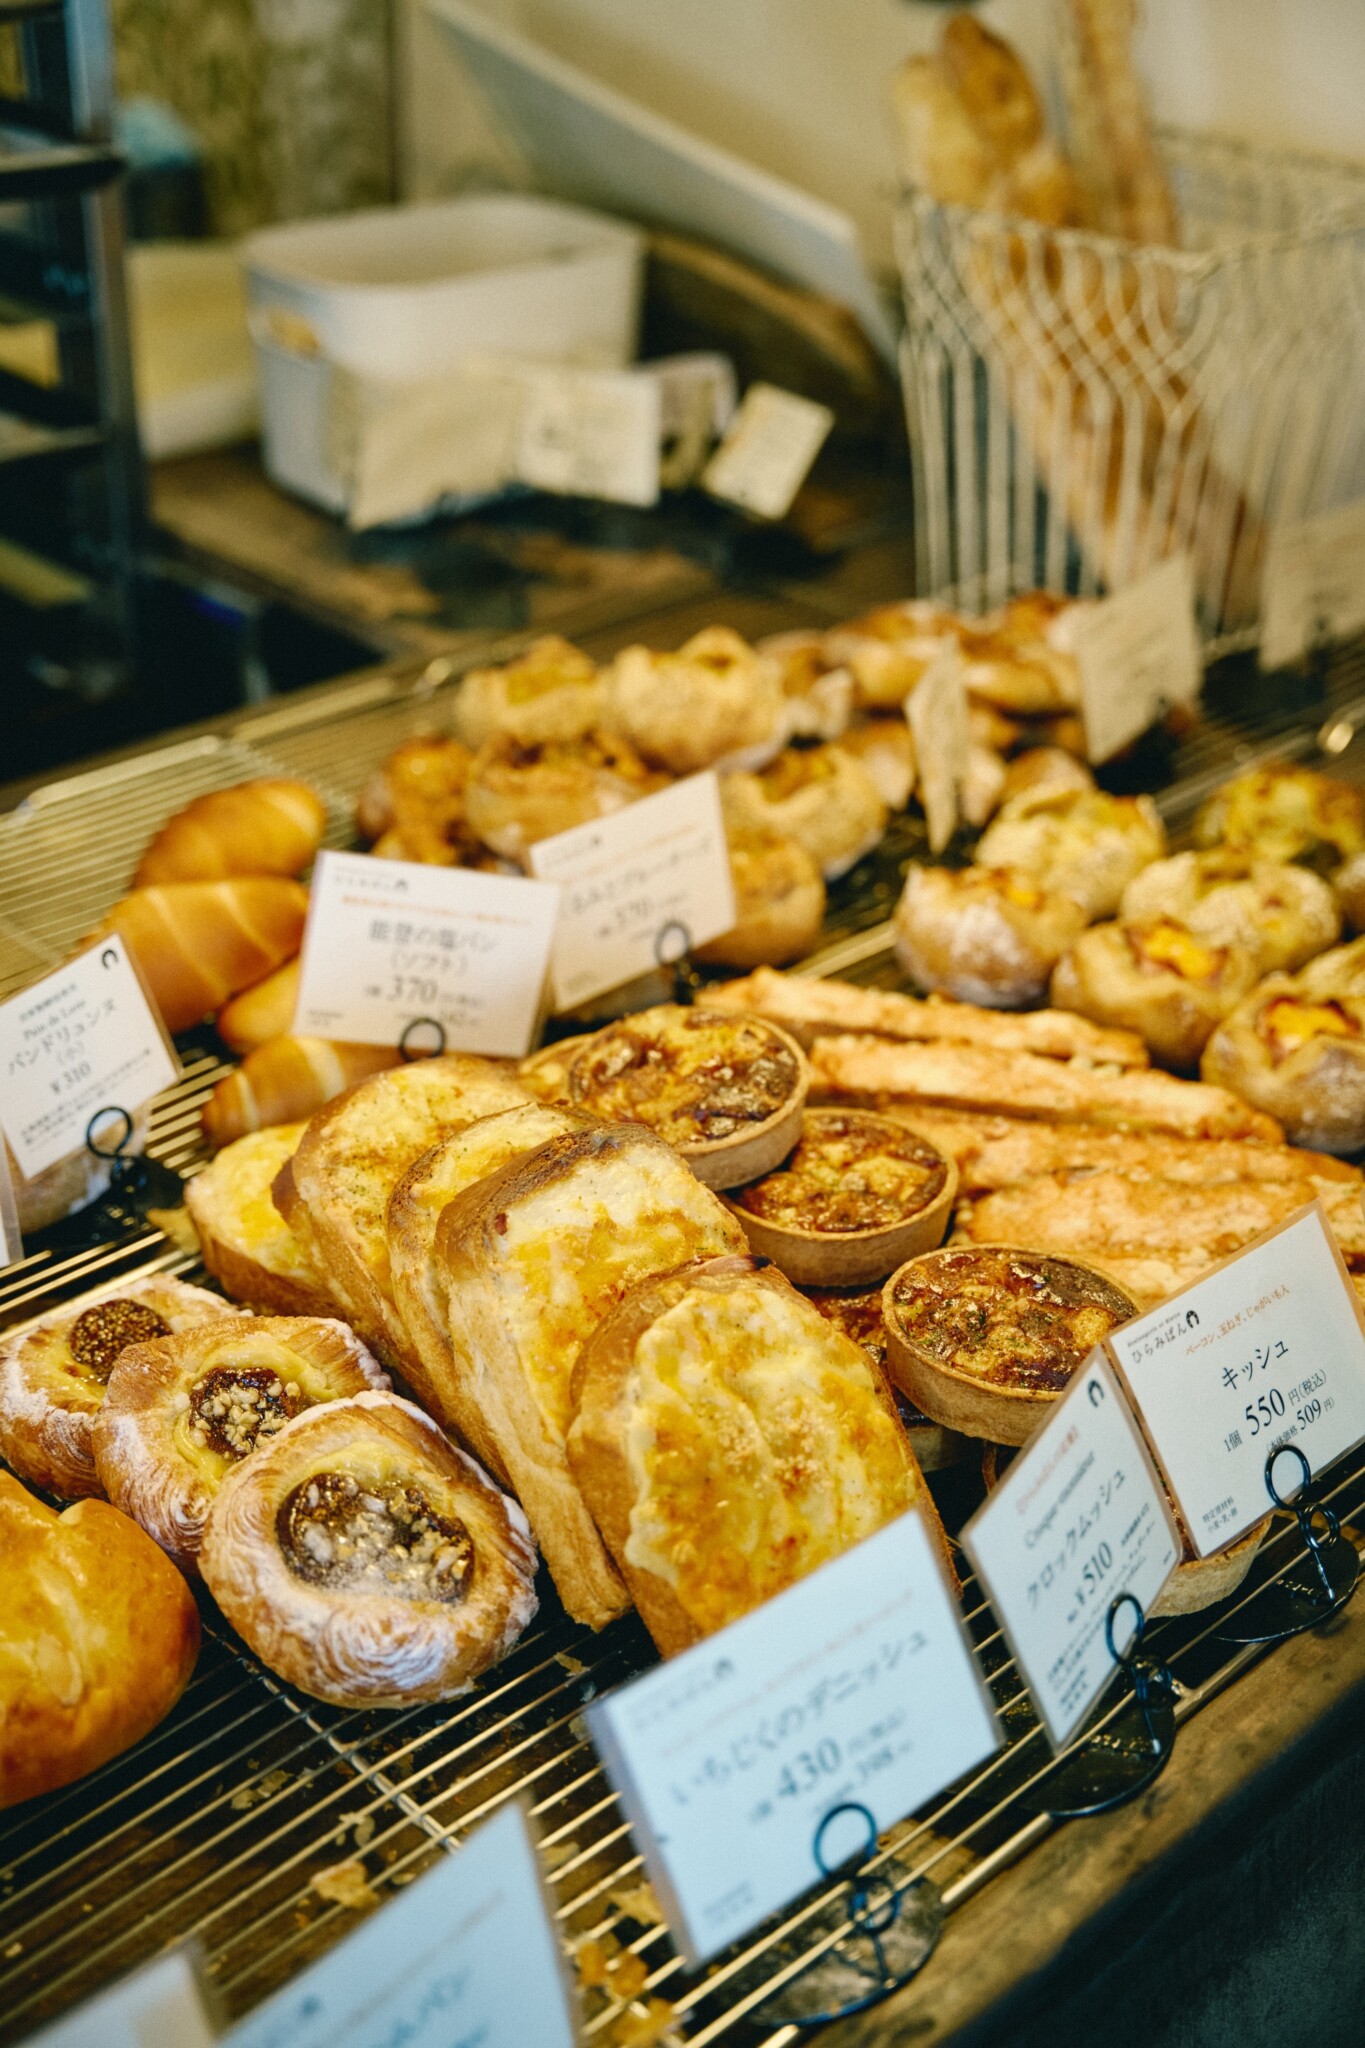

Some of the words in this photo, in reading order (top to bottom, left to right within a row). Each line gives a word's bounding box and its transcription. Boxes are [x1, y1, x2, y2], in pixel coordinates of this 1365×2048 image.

[388, 975, 439, 1005] 370
[1131, 1323, 1188, 1364] ひらみぱん
[1222, 1340, 1289, 1390] キッシュ
[1245, 1388, 1286, 1436] 550
[1296, 1398, 1322, 1431] 509
[1028, 1469, 1126, 1603] クロックムッシュ
[777, 1739, 841, 1798] 430
